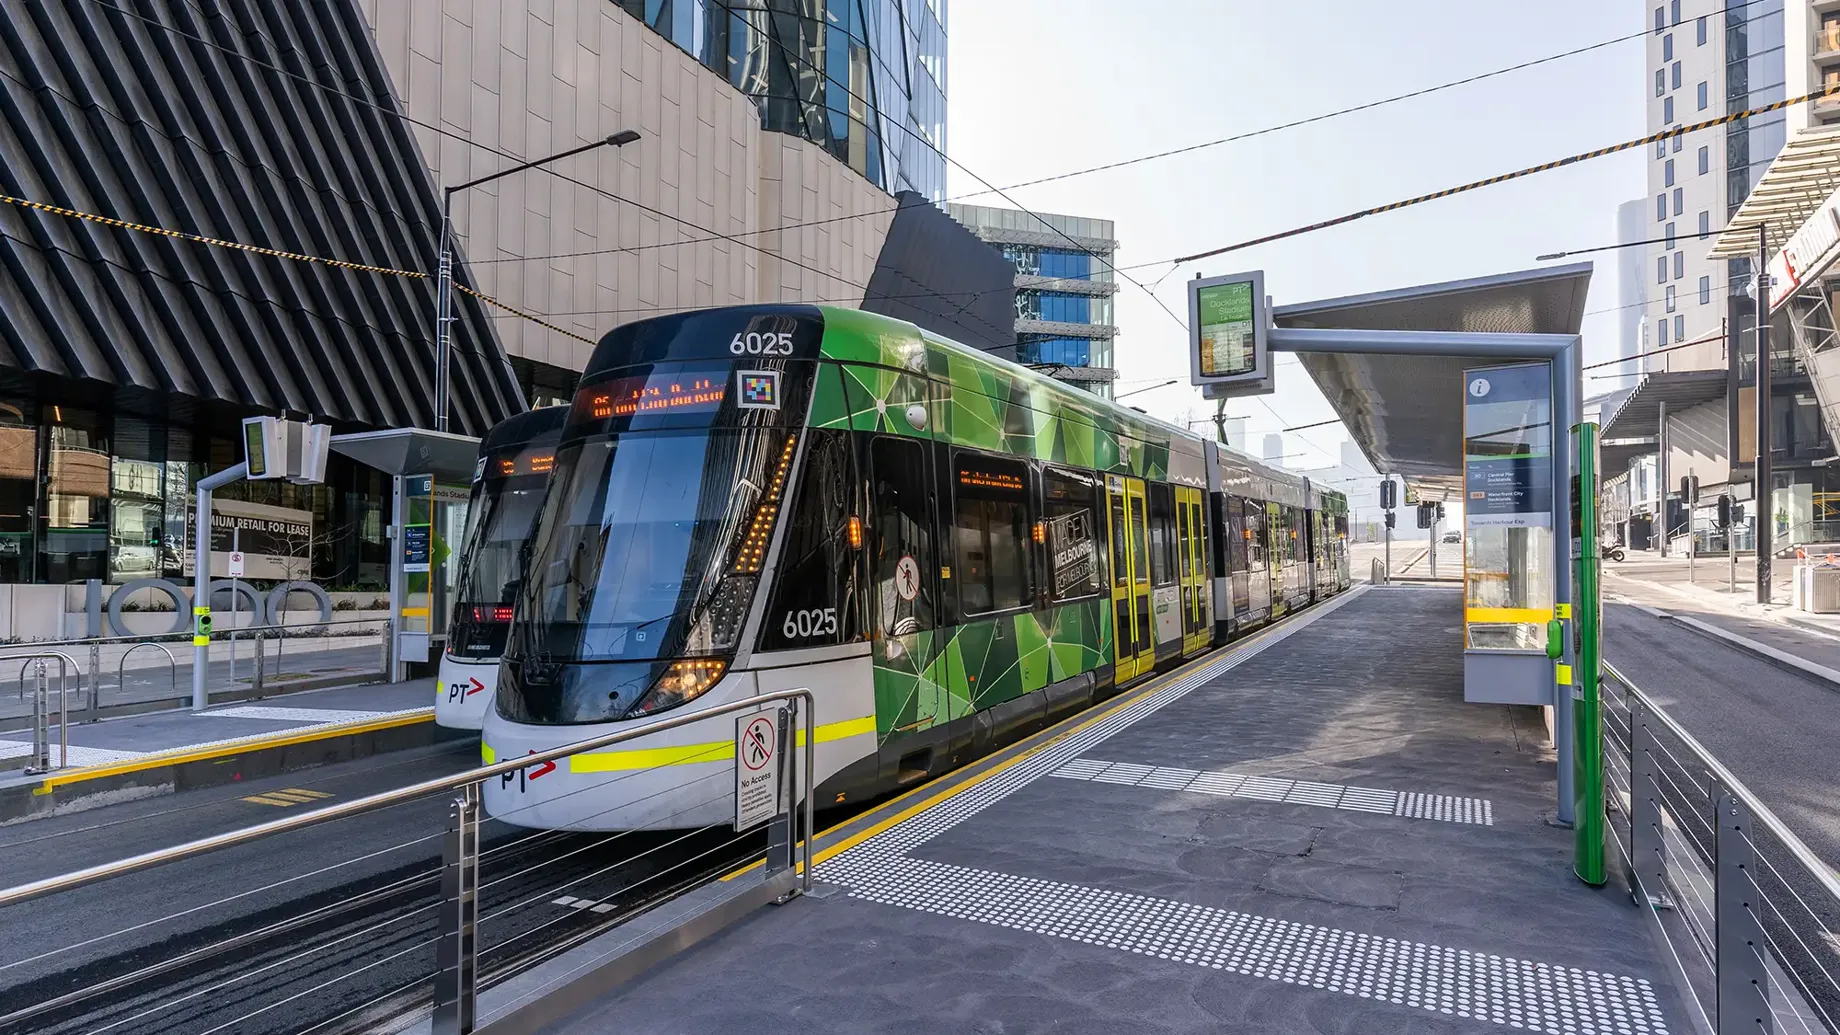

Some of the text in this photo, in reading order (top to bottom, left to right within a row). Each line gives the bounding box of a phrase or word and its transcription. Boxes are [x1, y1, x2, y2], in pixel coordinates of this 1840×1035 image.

[1210, 297, 1249, 308] Docklands
[1218, 305, 1250, 315] Stadium
[729, 332, 794, 356] 6025
[188, 512, 309, 536] PMIUM RETAIL FOR LEASE
[1055, 539, 1092, 569] MELBOURNE
[1056, 562, 1097, 591] FOR MELBOURNE
[783, 607, 837, 639] 6025
[741, 772, 771, 788] No Access
